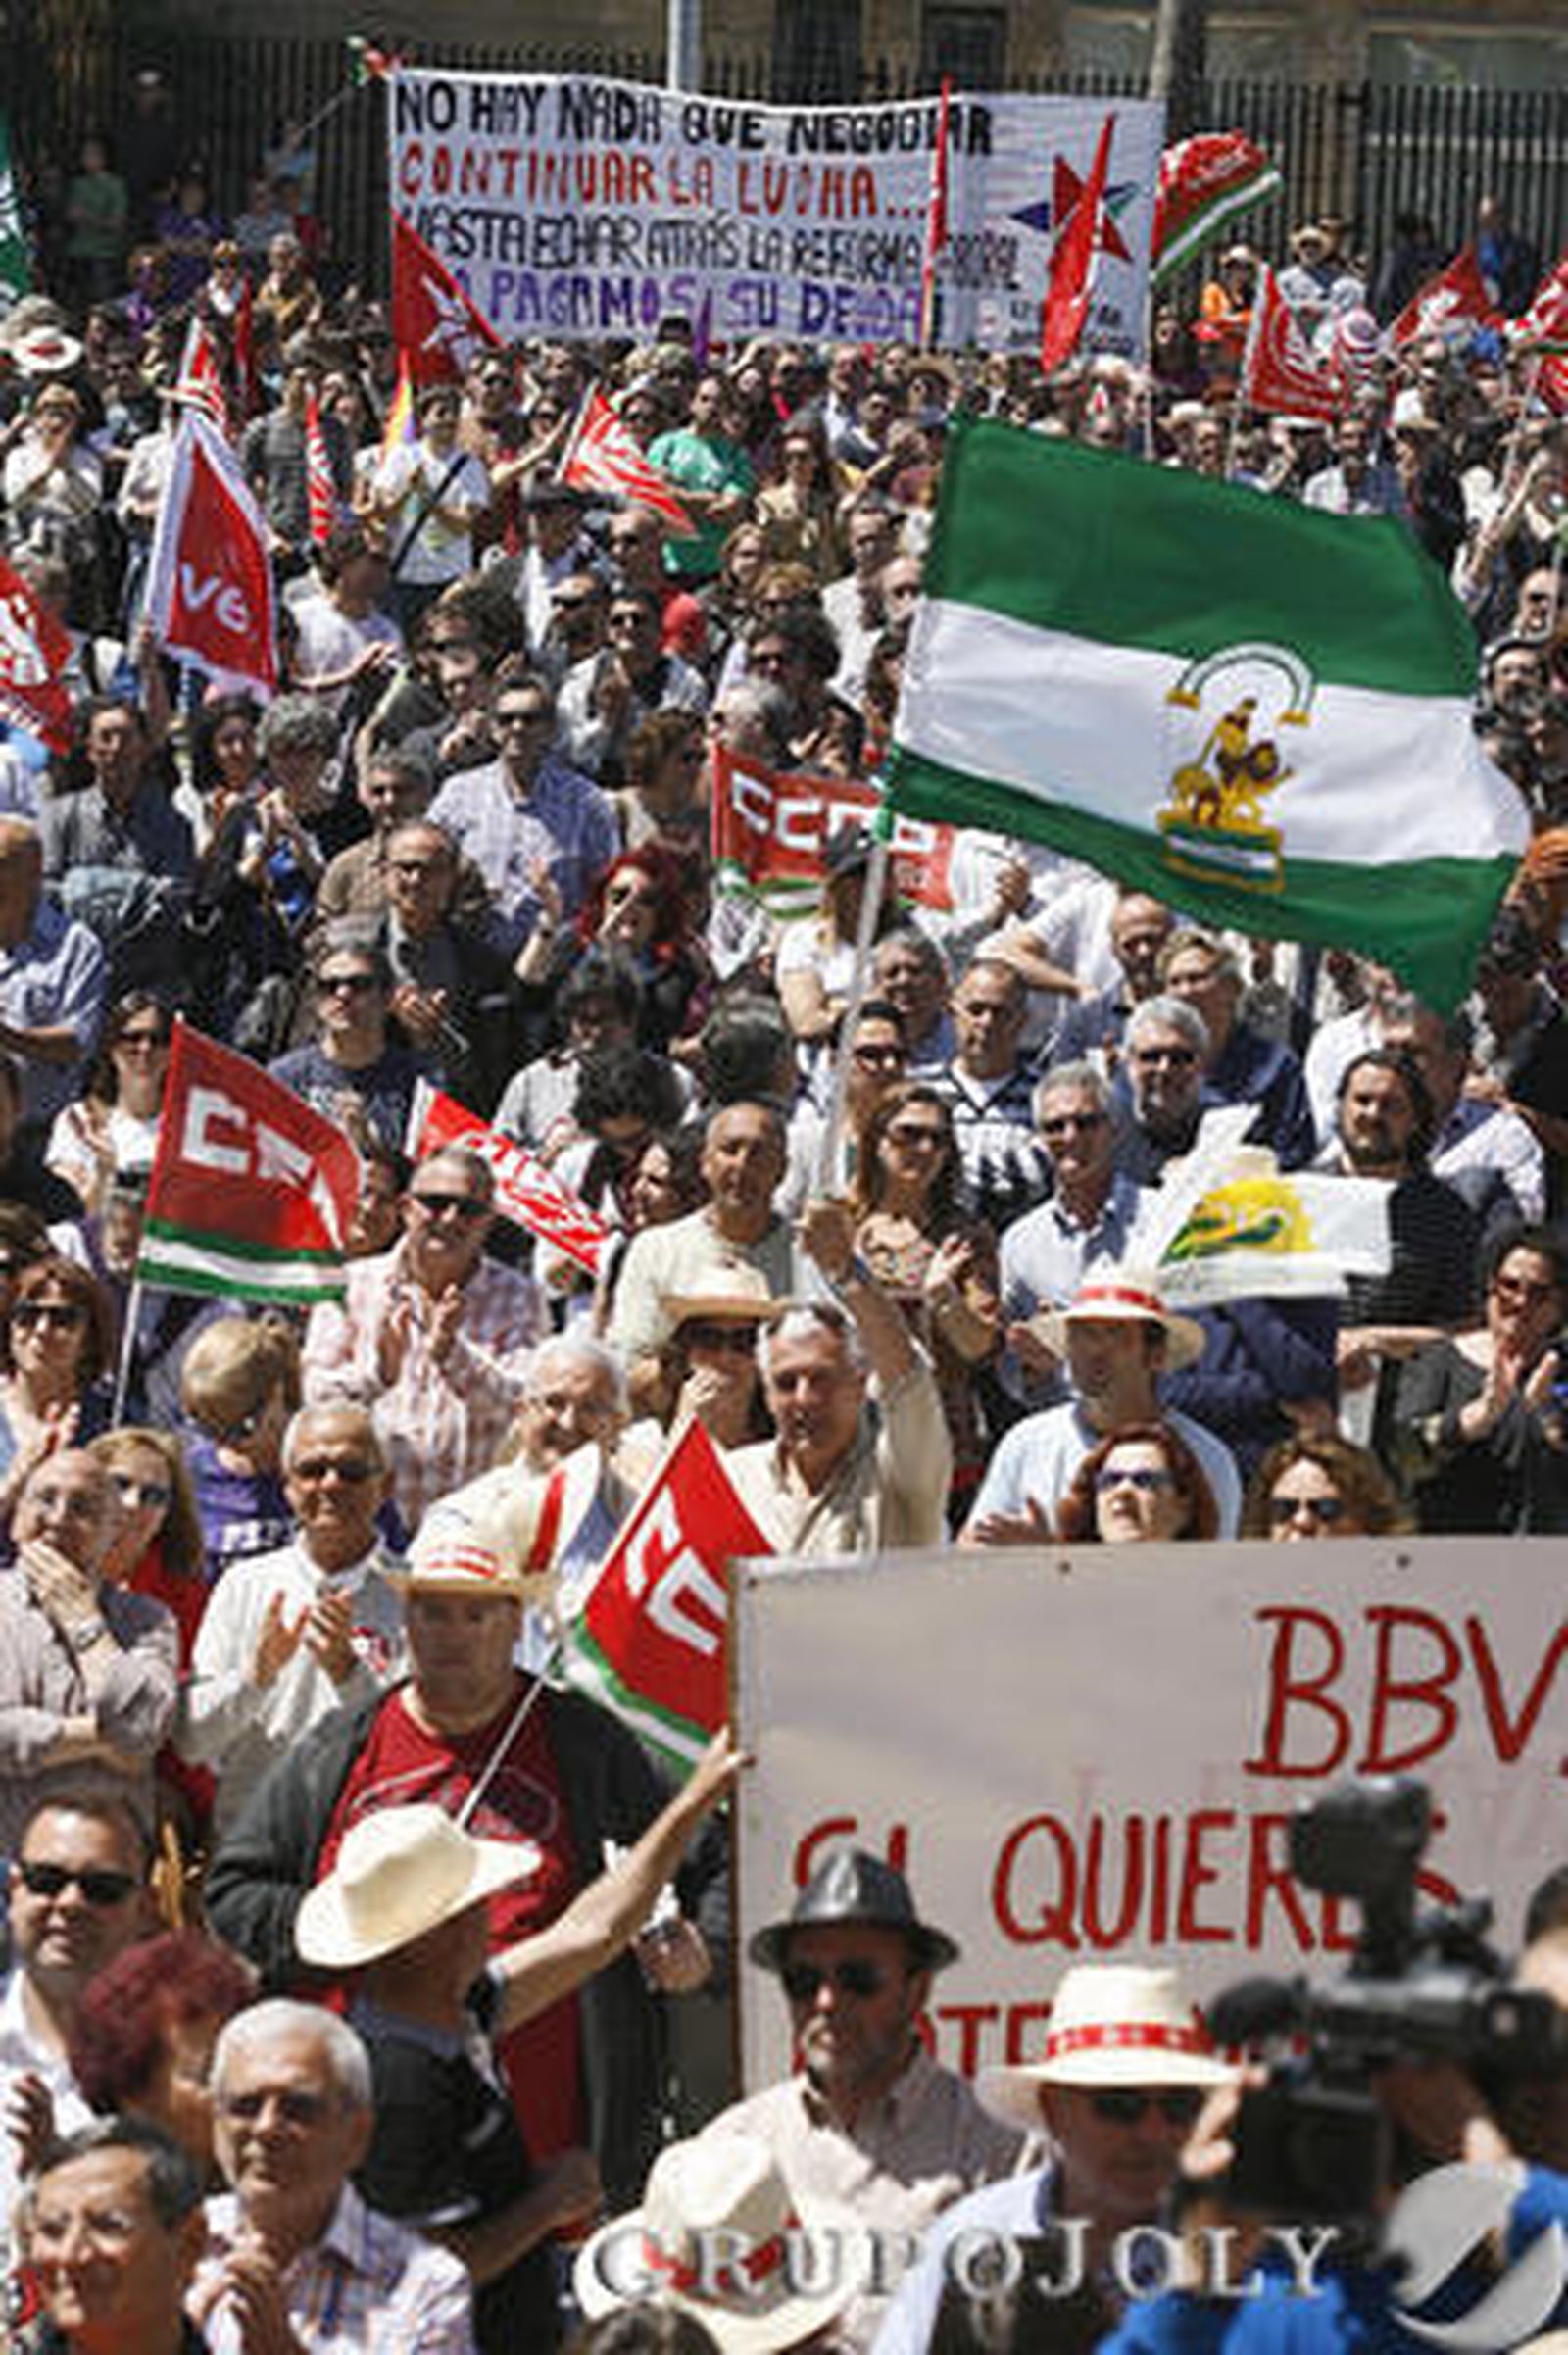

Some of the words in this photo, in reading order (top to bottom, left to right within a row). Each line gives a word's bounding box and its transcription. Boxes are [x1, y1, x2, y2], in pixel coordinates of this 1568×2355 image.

[395, 81, 456, 134] NO
[469, 82, 548, 138] HAY
[557, 82, 662, 145] NADA
[398, 144, 656, 207] CONTINUAR
[667, 157, 713, 211] LA
[748, 223, 782, 280] LA
[490, 270, 695, 329] PAGAMOS
[726, 276, 778, 328] SU
[1245, 1605, 1568, 1778] BBV
[991, 1813, 1460, 1951] QUIER
